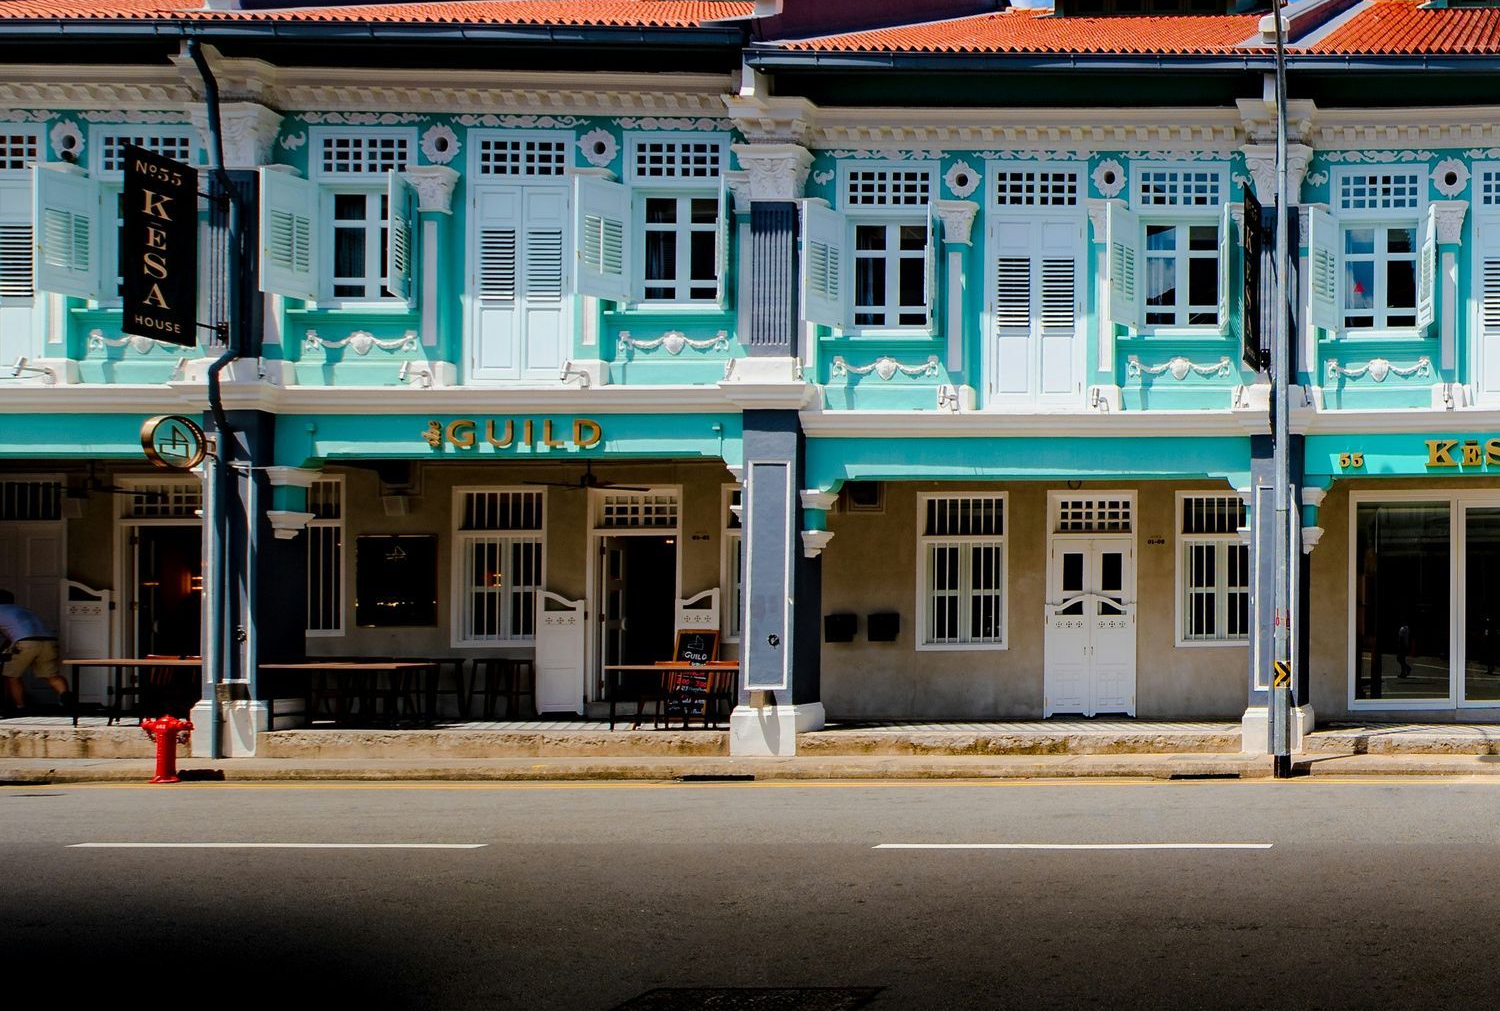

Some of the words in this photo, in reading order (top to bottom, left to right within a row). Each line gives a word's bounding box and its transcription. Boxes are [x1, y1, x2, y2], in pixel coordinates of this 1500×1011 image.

[135, 314, 182, 334] HOUSE
[445, 419, 602, 448] GUILD
[1338, 452, 1363, 468] 55
